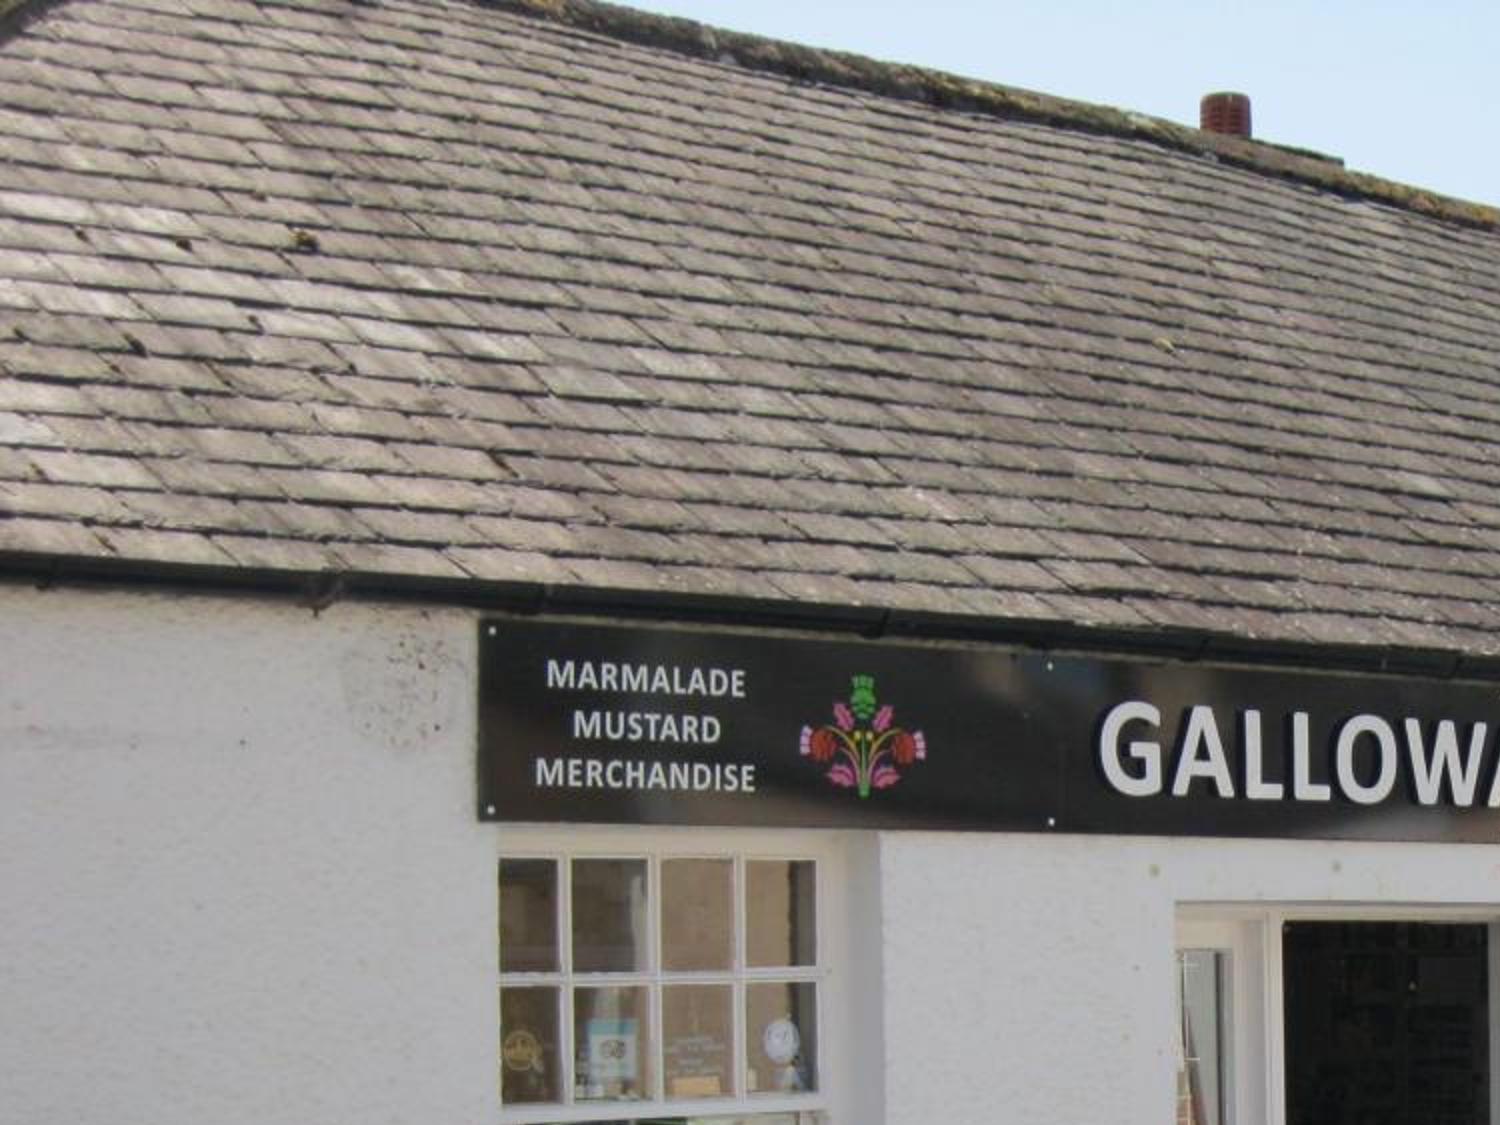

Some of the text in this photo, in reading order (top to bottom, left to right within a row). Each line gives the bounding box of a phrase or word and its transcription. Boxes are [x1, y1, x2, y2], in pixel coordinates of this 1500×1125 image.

[547, 659, 745, 698] MARMALADE
[574, 710, 721, 743] MUSTARD
[536, 757, 755, 793] MERCHANDISE
